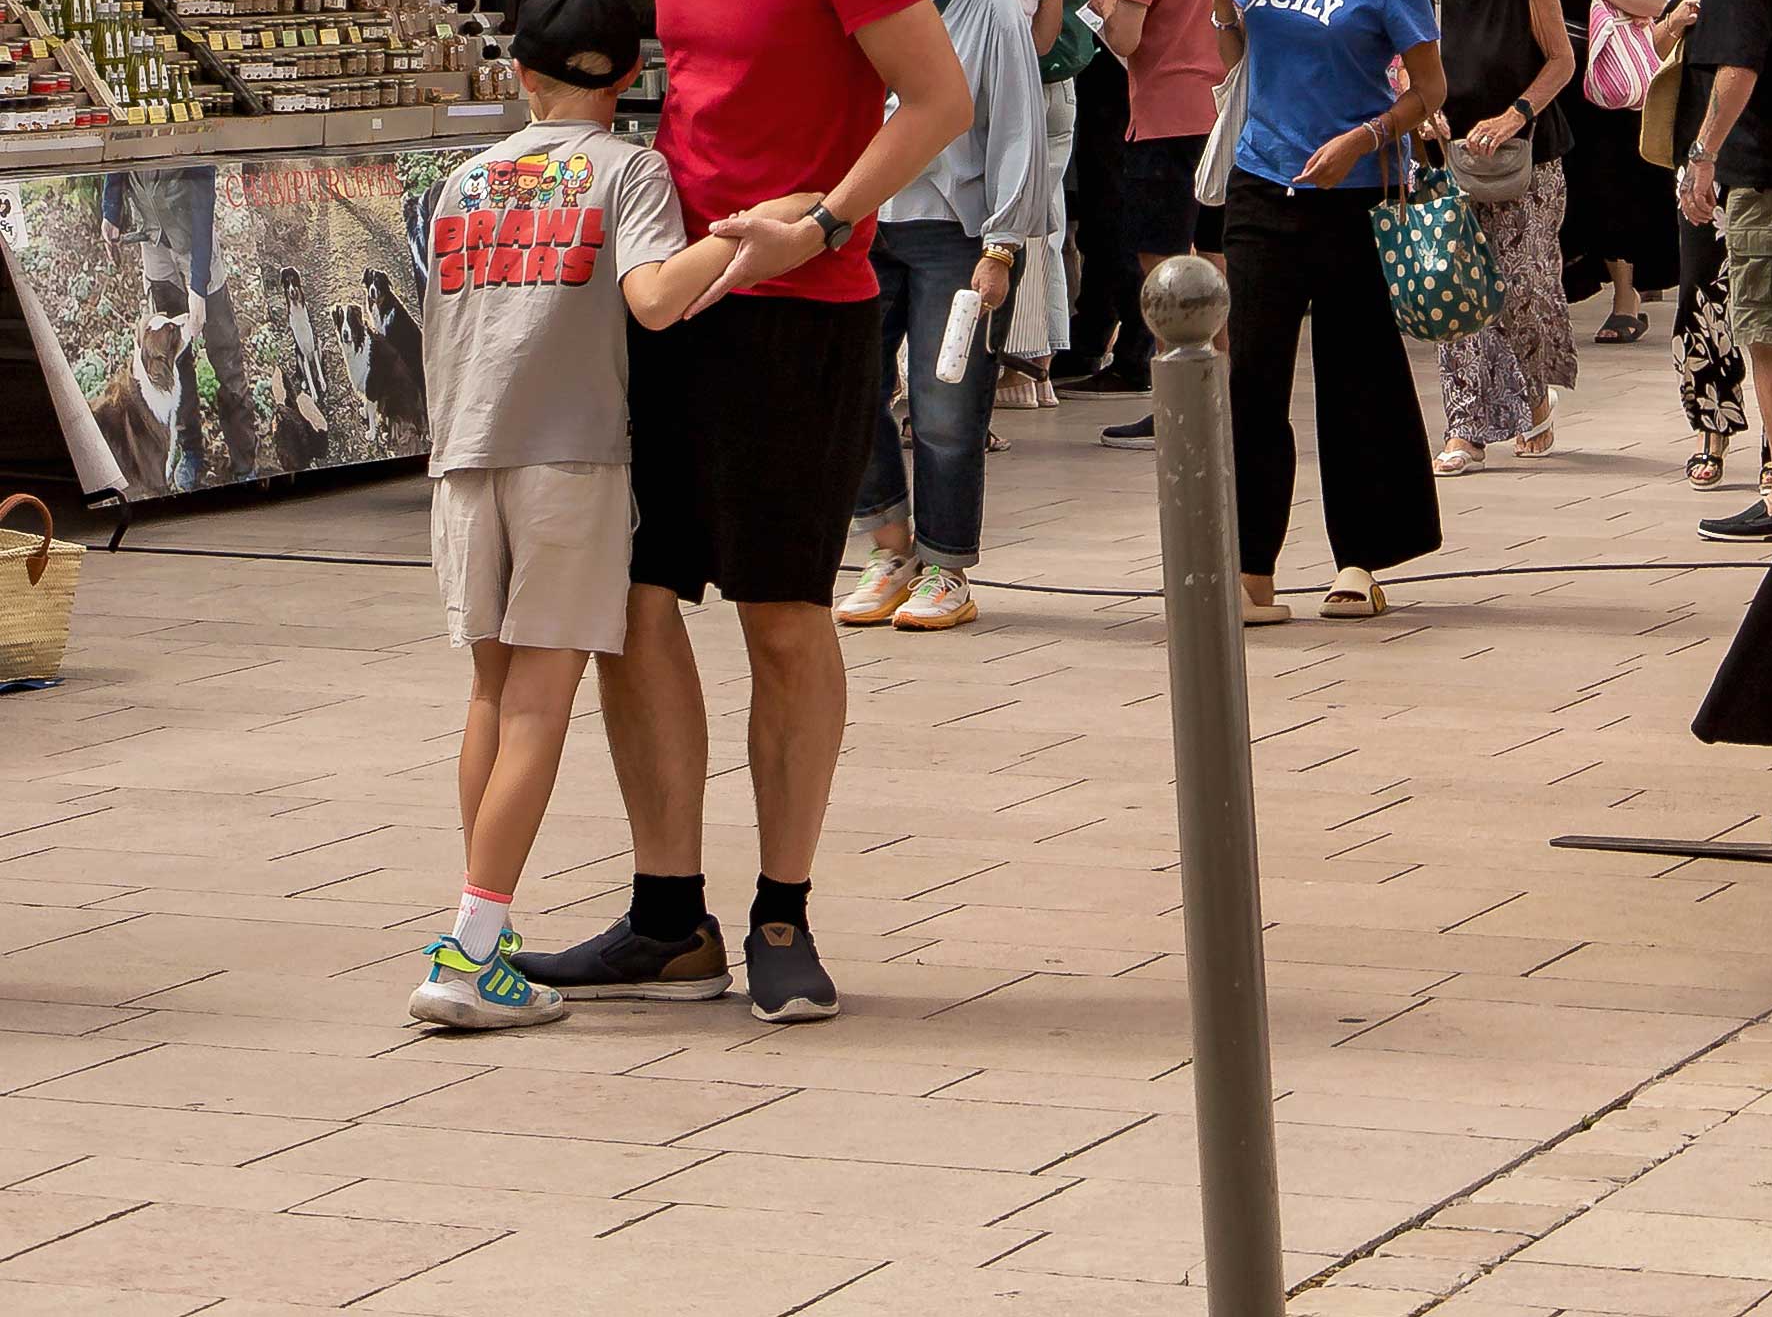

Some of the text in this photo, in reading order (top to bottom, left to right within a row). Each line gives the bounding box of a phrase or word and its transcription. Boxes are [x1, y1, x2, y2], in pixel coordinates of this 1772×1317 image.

[226, 164, 404, 209] CHAMPITRUFFES
[434, 207, 606, 258] BRAWL
[440, 246, 597, 295] STARS
